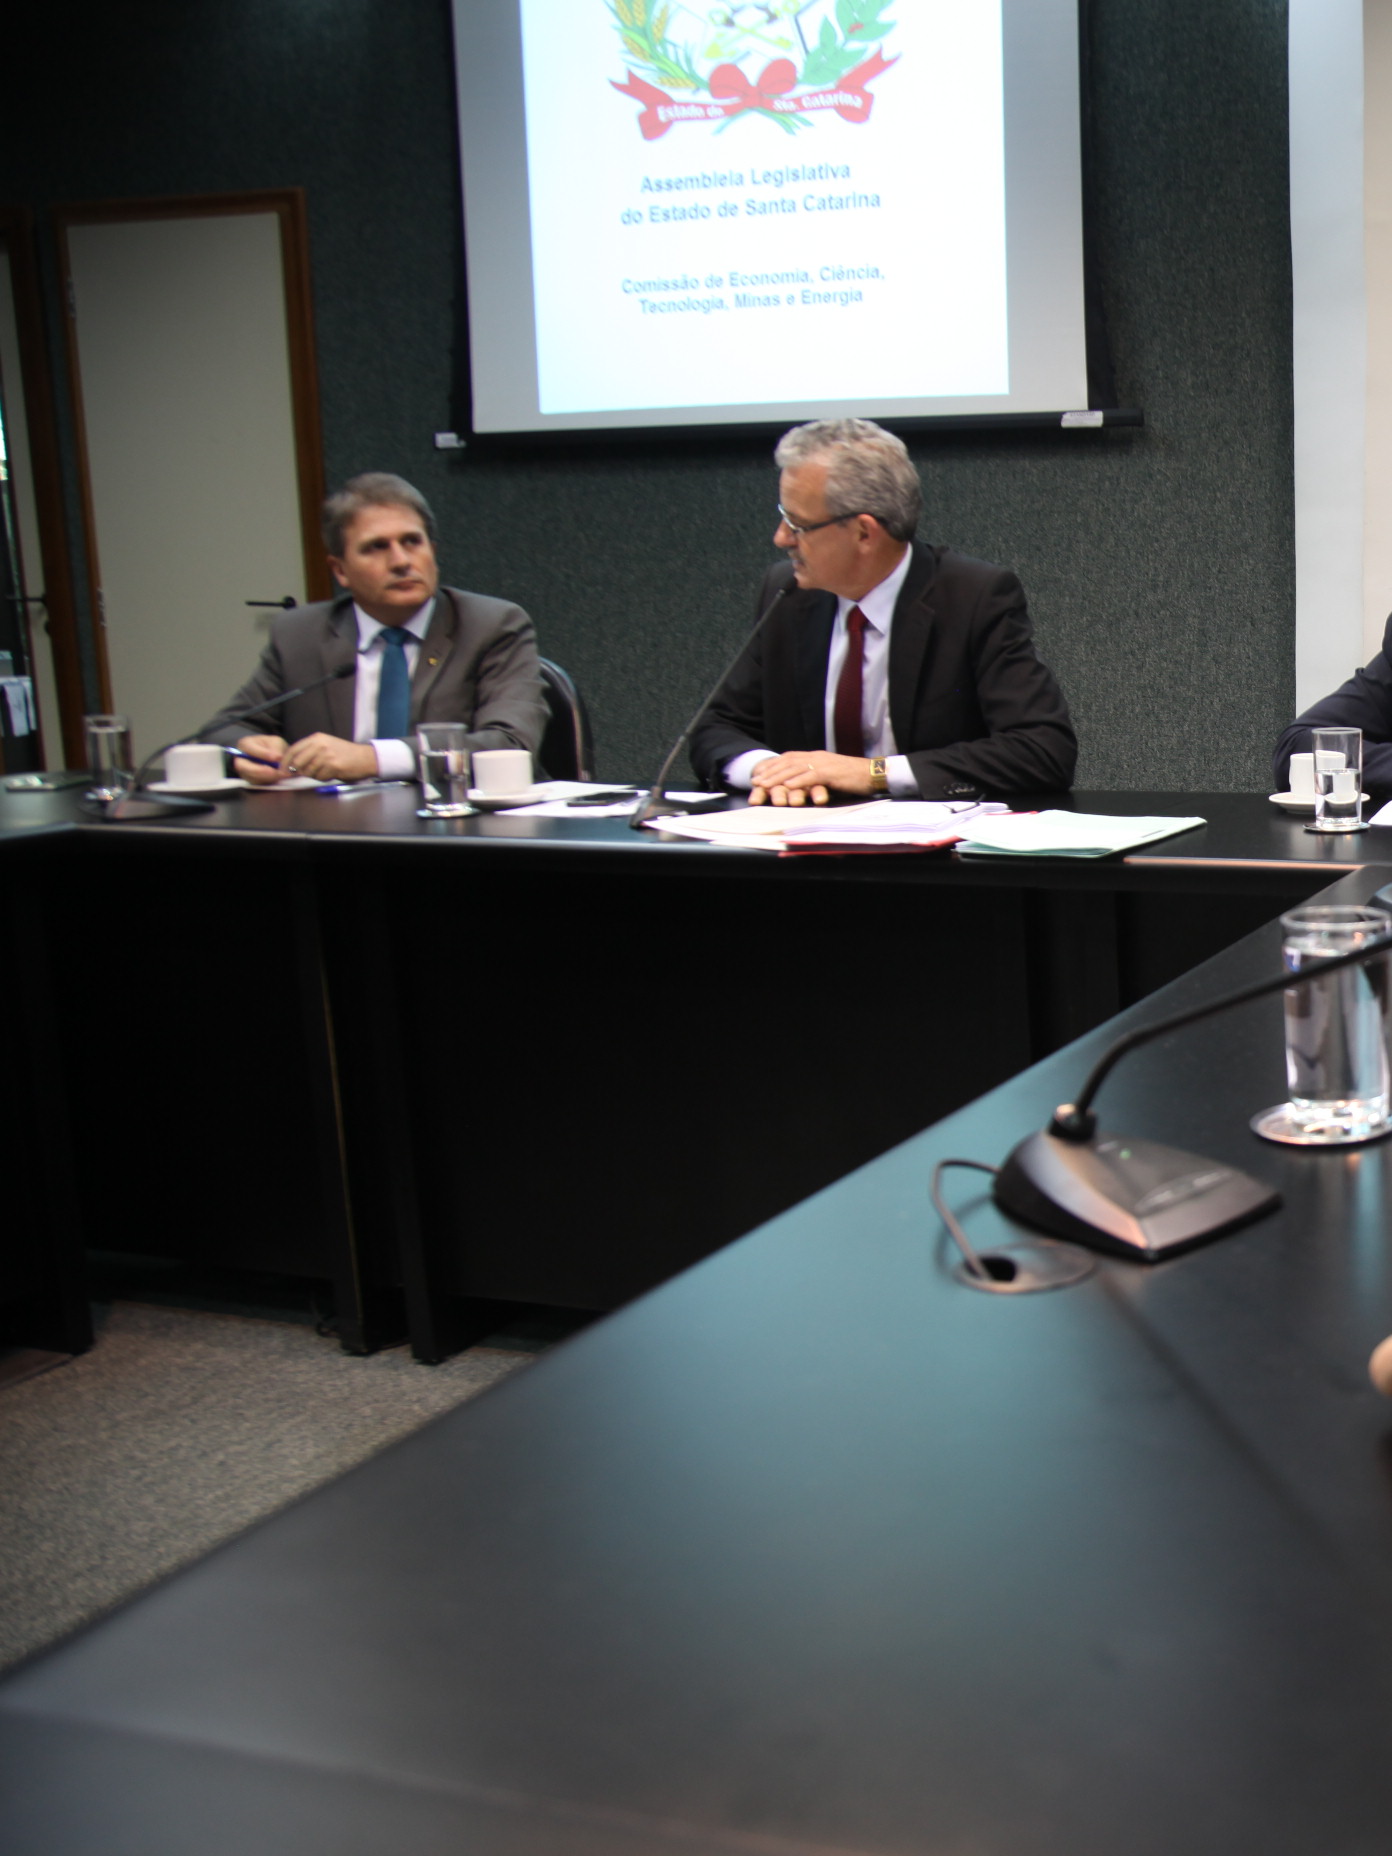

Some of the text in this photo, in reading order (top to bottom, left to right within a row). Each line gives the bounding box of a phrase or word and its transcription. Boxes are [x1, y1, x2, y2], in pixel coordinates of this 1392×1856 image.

[657, 105, 706, 123] Estado
[640, 163, 851, 193] Assembleia Legislativa
[620, 191, 882, 225] do Estado de Santa Catarina
[621, 264, 885, 294] Comissão de Economia, Ciência,
[639, 287, 864, 314] Tecnologia, Minas e Energia
